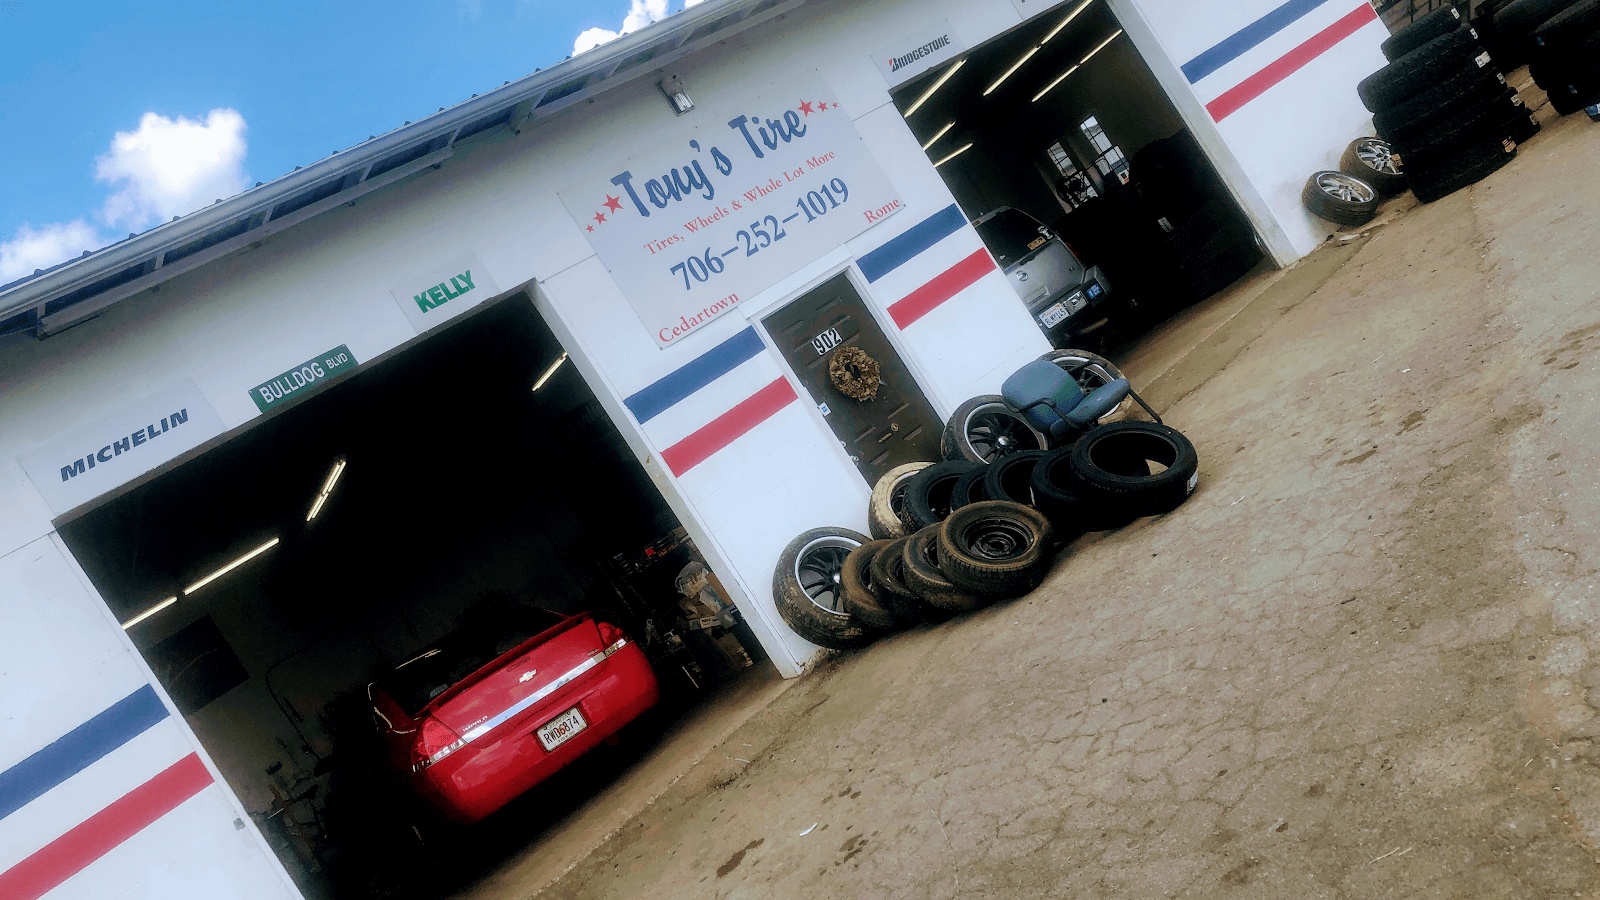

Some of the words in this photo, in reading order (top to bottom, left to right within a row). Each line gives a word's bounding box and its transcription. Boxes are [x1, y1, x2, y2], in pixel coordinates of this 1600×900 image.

[888, 34, 951, 73] BRIDGESTONE
[610, 139, 732, 217] Tony's
[728, 109, 807, 159] Tire
[644, 233, 685, 256] Tires,
[683, 205, 731, 235] Wheels
[731, 199, 743, 210] &
[743, 176, 783, 204] Whole
[782, 165, 805, 183] Lot
[805, 150, 836, 170] More
[862, 198, 901, 224] Rome
[413, 269, 476, 314] KELLY
[659, 293, 740, 343] Cedartown
[813, 327, 841, 354] 902
[258, 361, 325, 404] BULLDOG
[325, 351, 348, 371] BLVD
[60, 408, 189, 482] MICHELIN
